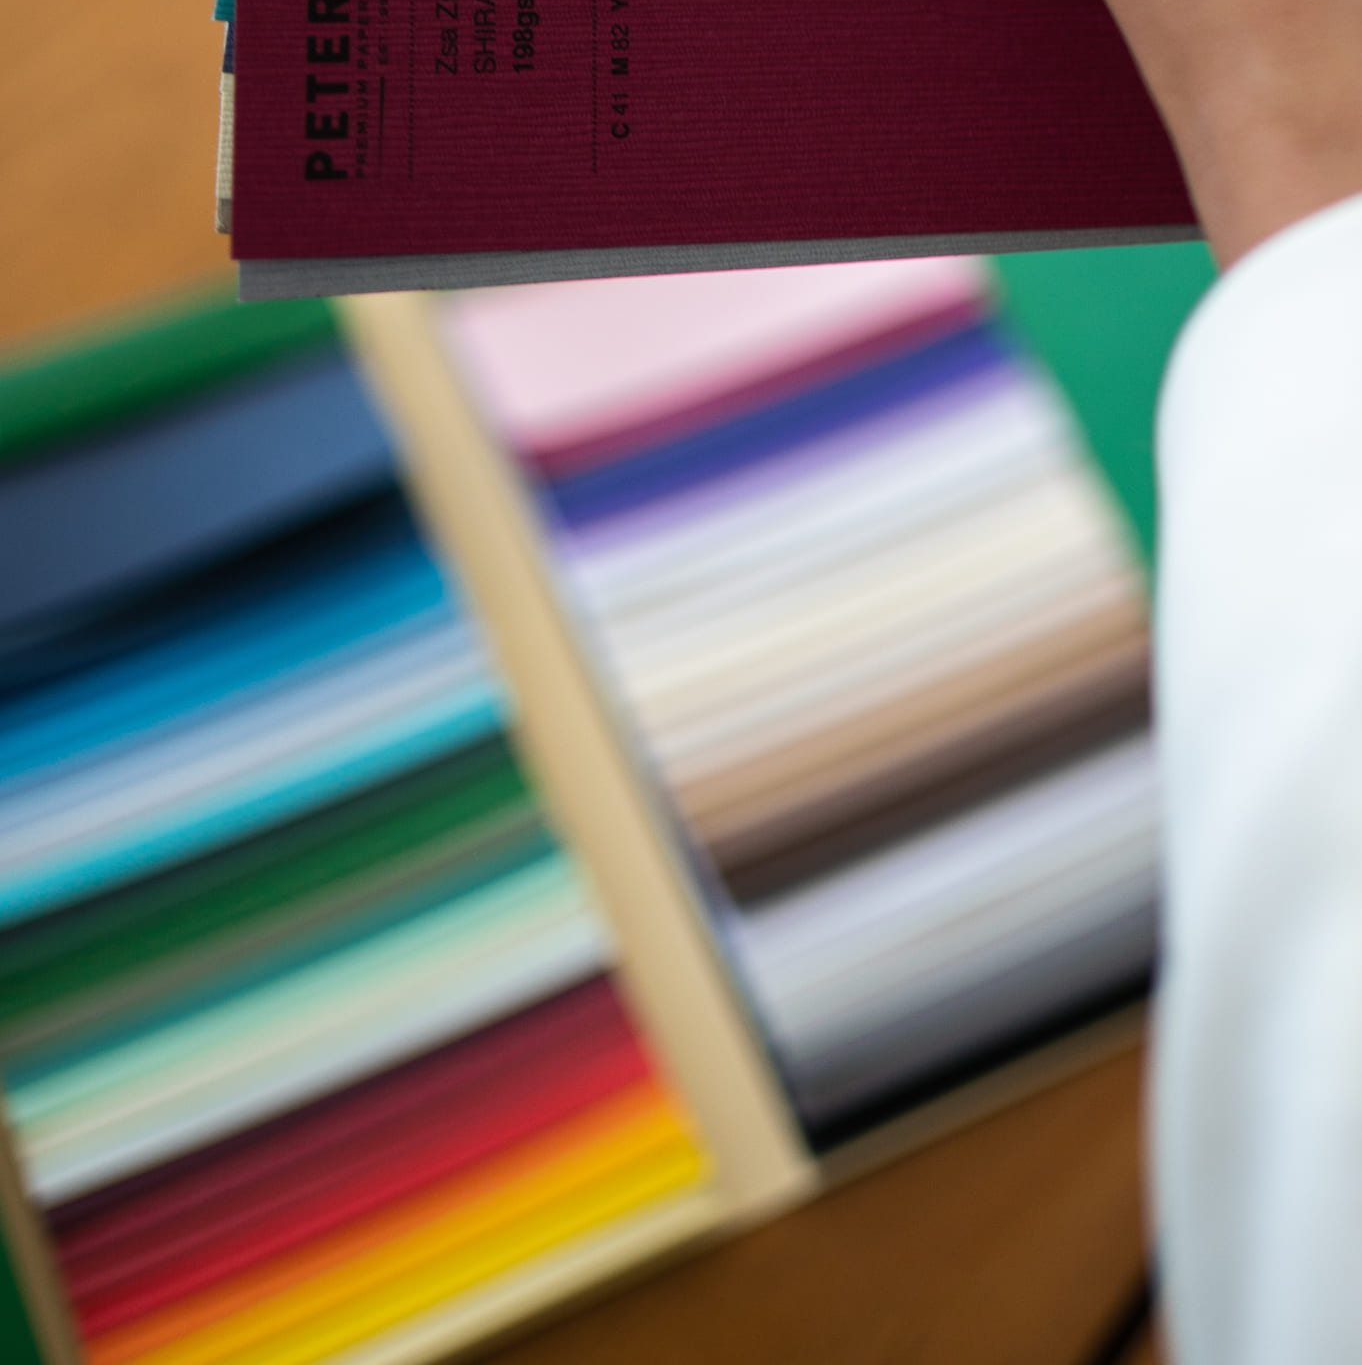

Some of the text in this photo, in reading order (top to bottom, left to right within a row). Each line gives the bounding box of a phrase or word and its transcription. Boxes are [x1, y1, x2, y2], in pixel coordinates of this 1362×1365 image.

[357, 0, 370, 69] PAPER
[611, 24, 629, 50] 82
[435, 27, 458, 75] Zsa
[611, 57, 628, 75] M
[612, 93, 628, 116] 41
[355, 80, 369, 179] PREMIUM
[611, 121, 629, 140] C
